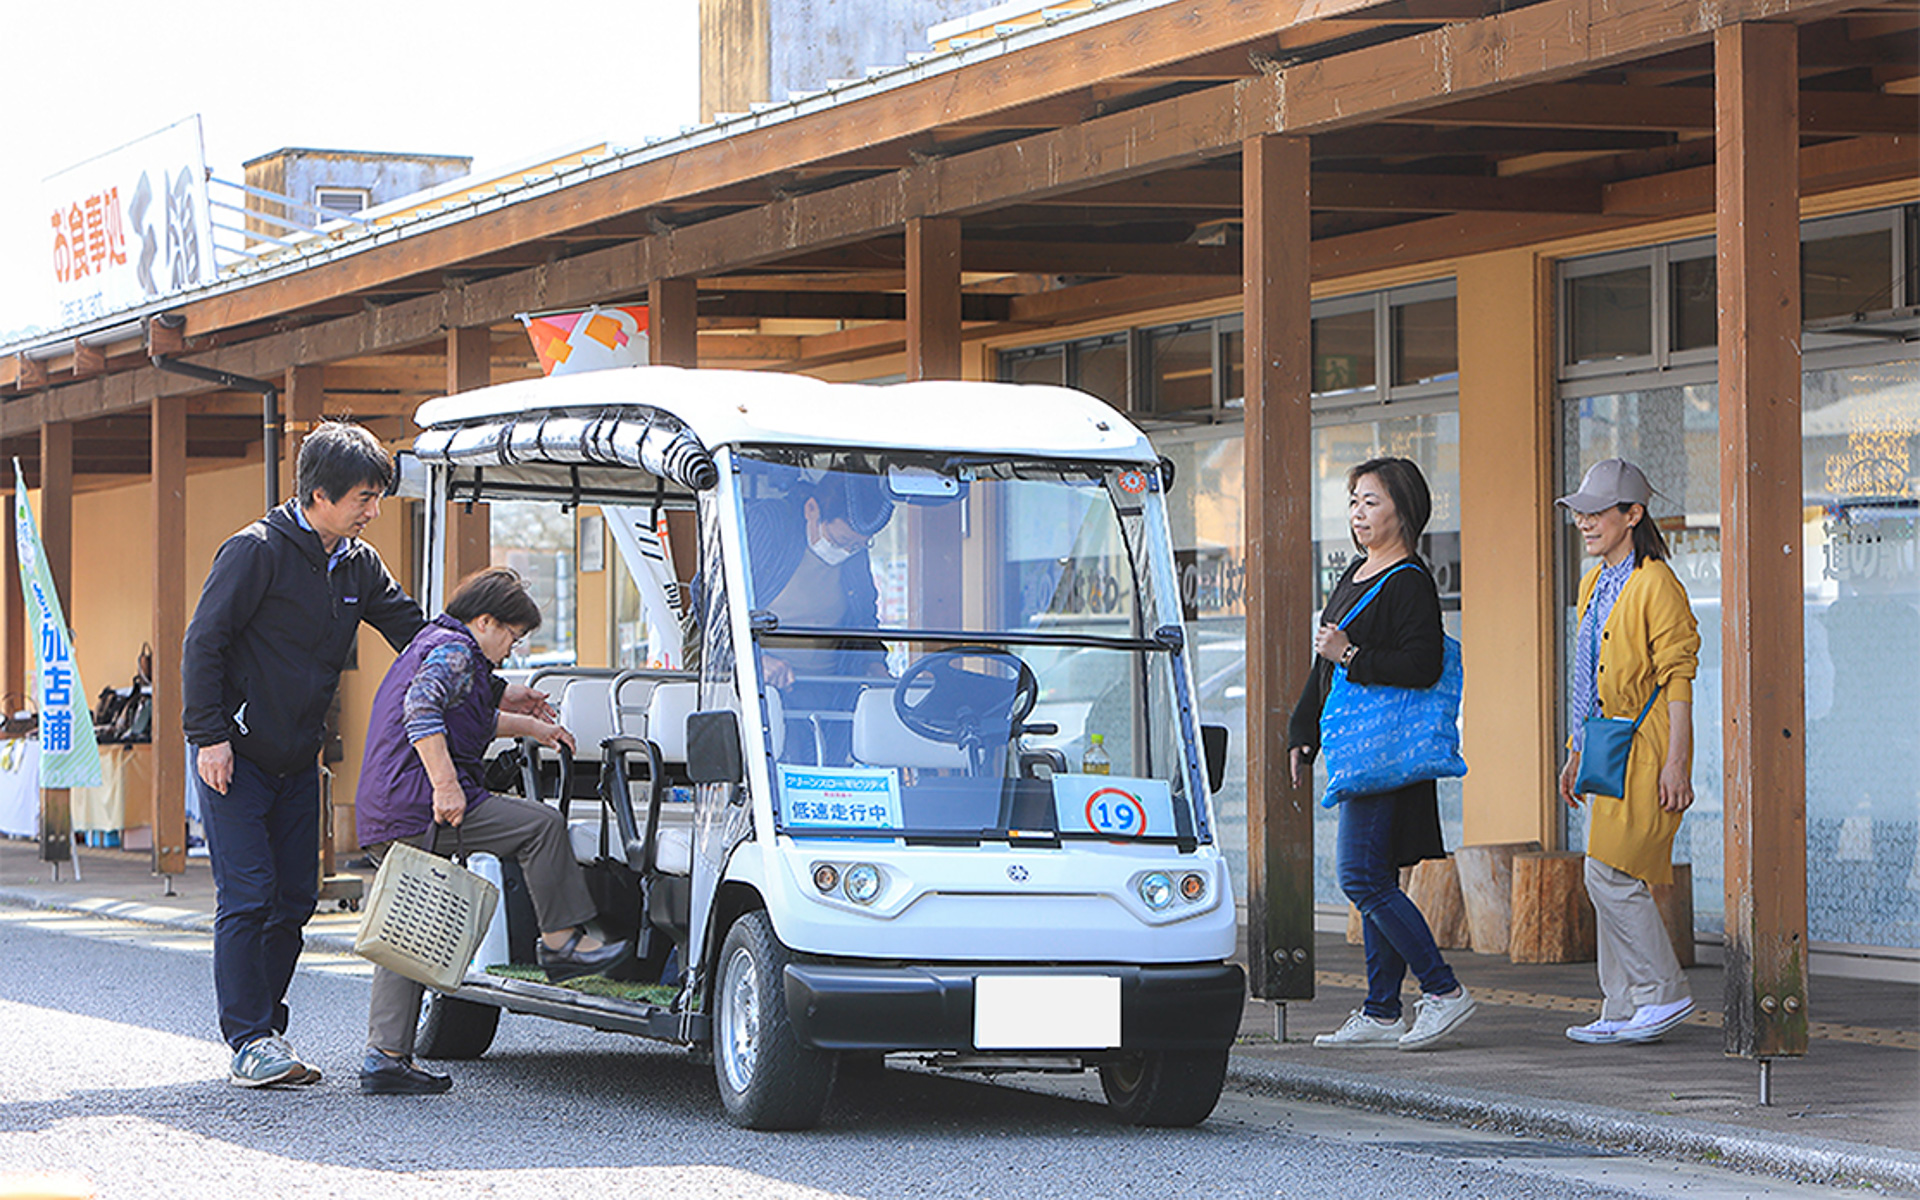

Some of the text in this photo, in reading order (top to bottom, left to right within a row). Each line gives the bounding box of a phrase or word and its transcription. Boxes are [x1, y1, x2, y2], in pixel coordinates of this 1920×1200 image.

[792, 801, 887, 821] 低速走行中
[1097, 802, 1134, 830] 19
